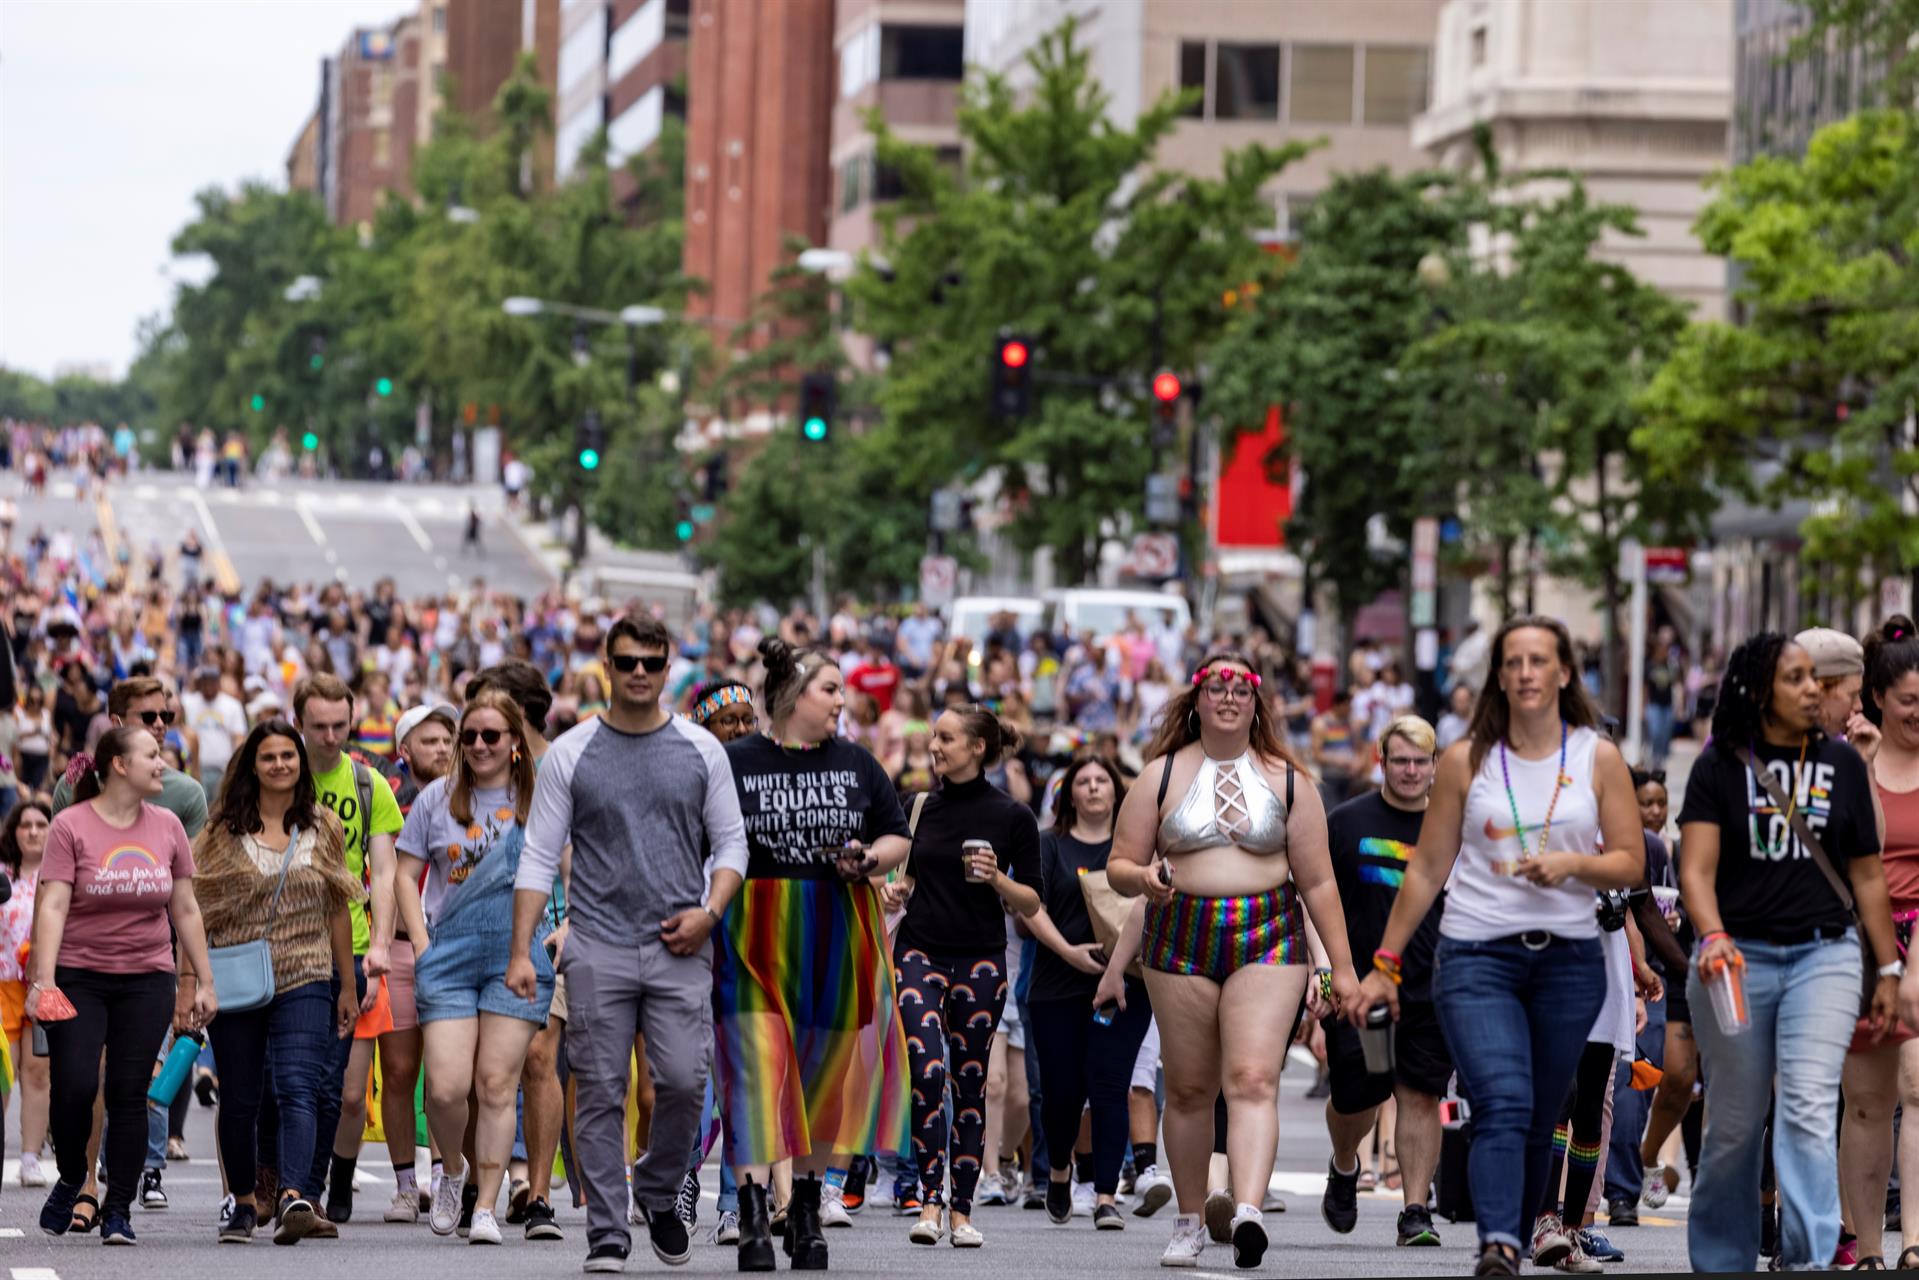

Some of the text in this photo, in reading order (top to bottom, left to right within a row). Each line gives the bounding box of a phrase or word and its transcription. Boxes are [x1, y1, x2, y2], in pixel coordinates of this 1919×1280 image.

[743, 769, 859, 793] WHITE SILENCE
[1745, 758, 1835, 811] LOVE
[760, 785, 848, 813] EQUALS
[744, 808, 864, 834] WHITE CONSENT
[756, 827, 851, 849] BLACK LIVES
[95, 867, 130, 882] Love
[132, 866, 154, 884] for
[86, 883, 114, 896] and
[116, 881, 135, 893] all
[137, 880, 159, 896] for
